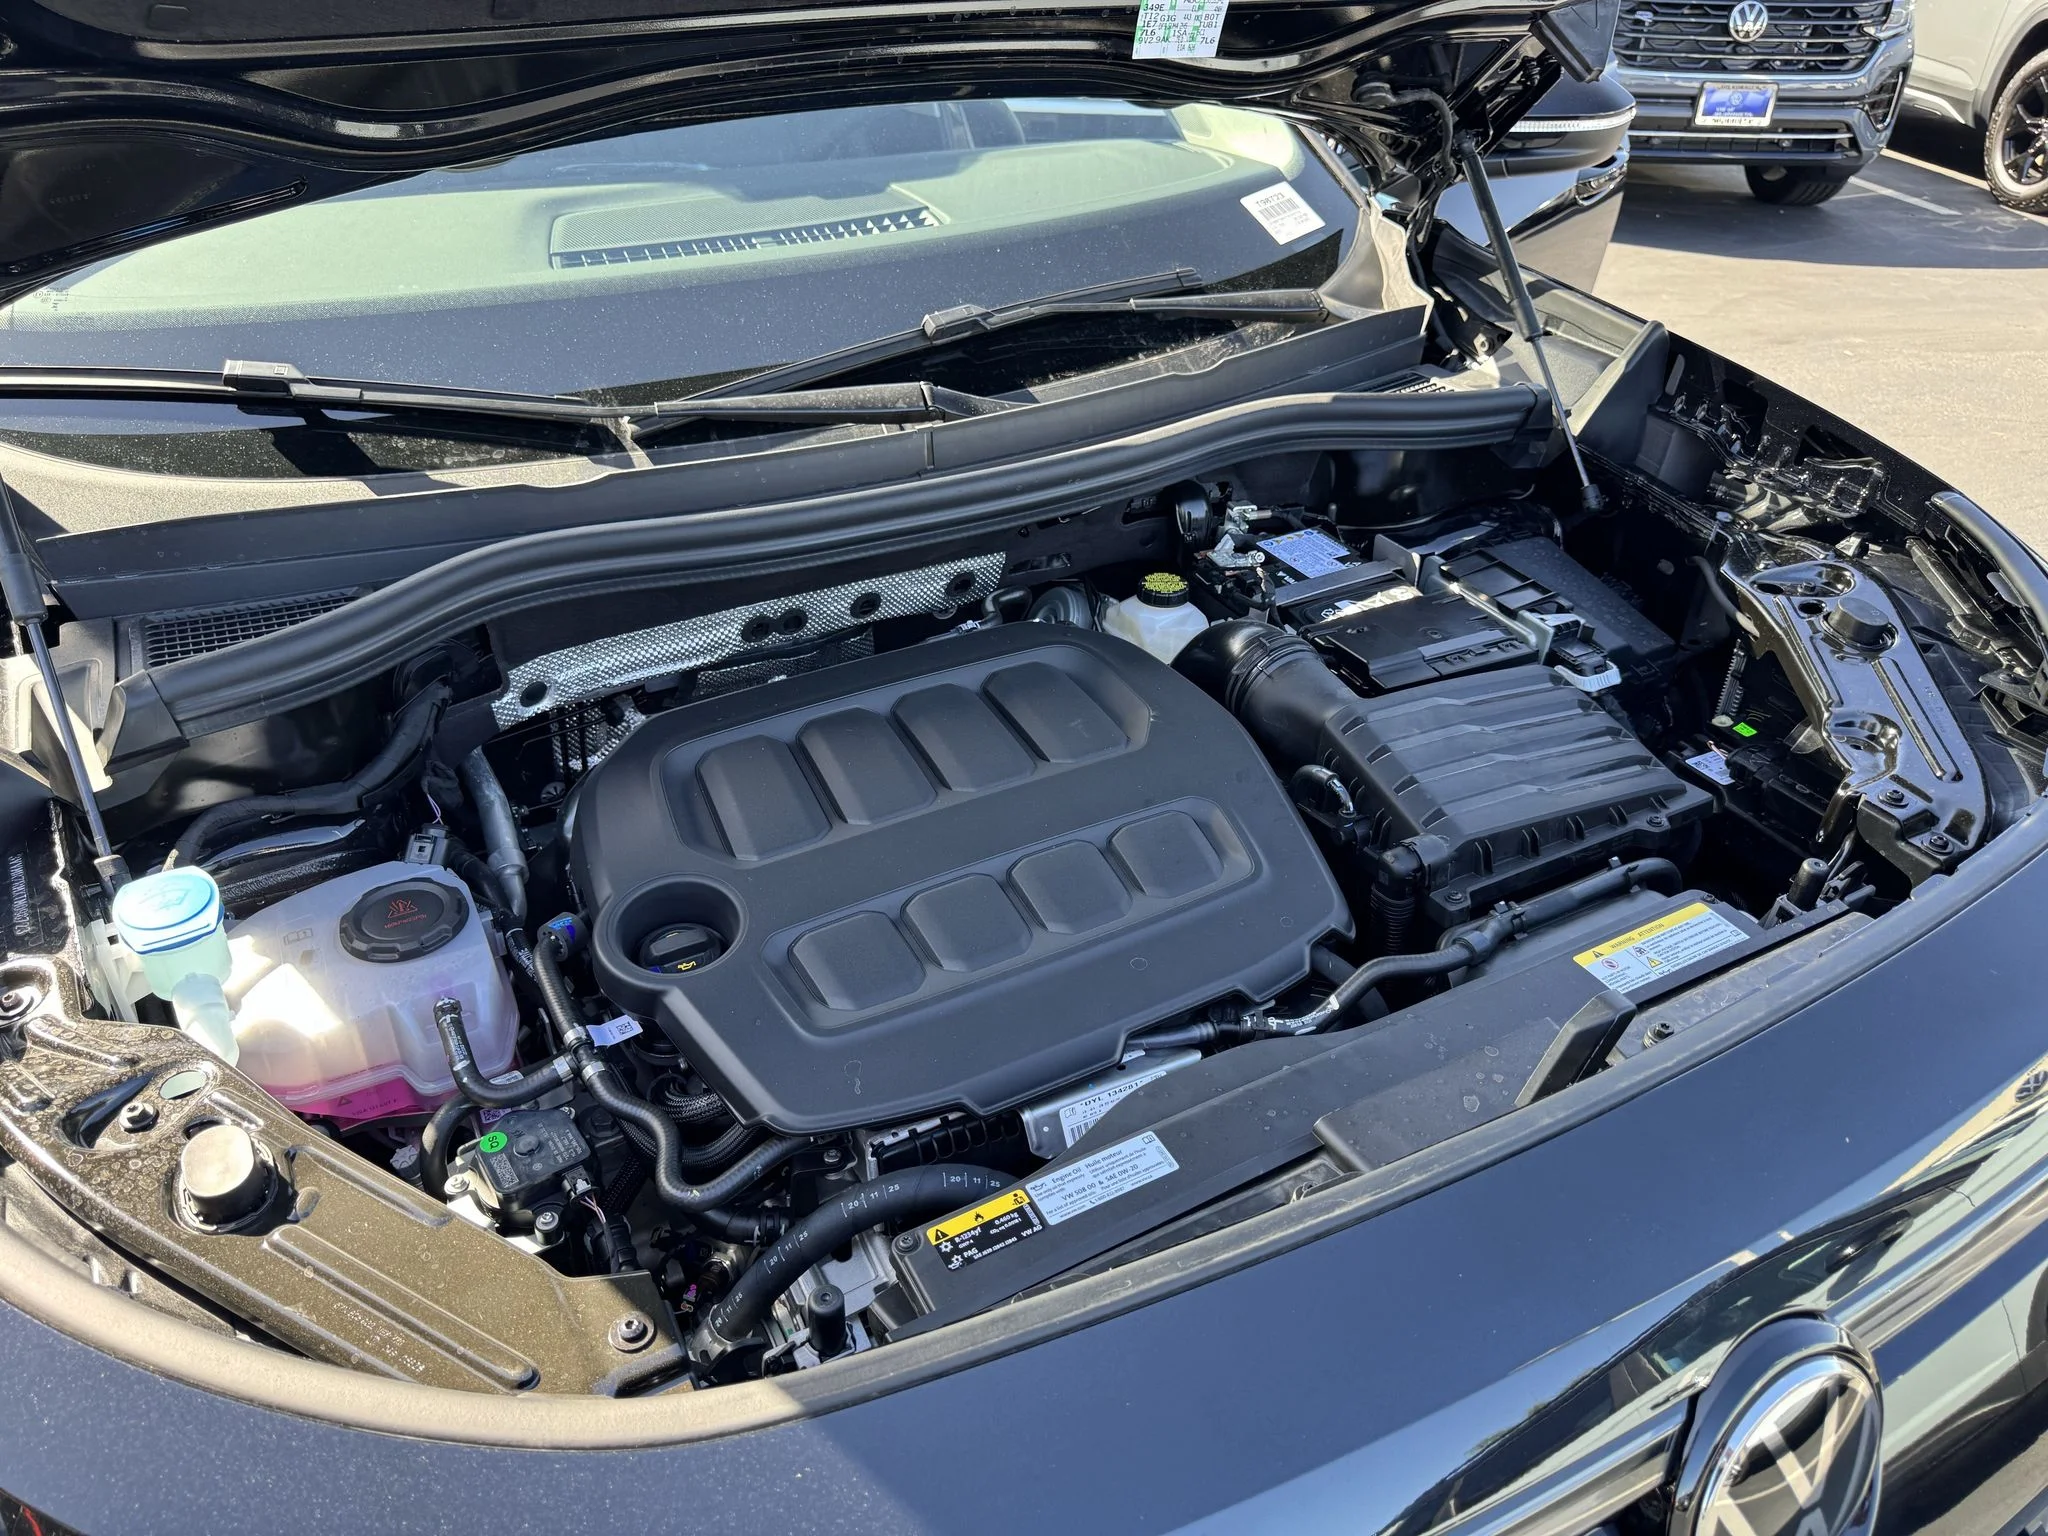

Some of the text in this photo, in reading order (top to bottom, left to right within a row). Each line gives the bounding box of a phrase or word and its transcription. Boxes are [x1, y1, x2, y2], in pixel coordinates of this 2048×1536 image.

[487, 1135, 499, 1148] SQ
[1085, 1149, 1122, 1168] Huile moteur
[1051, 1171, 1072, 1184] Engine
[1062, 1192, 1075, 1201] VW
[1074, 1186, 1087, 1195] 508
[1104, 1173, 1117, 1182] SAE
[1117, 1164, 1138, 1176] 0W-20
[1021, 1224, 1042, 1237] VW AG
[963, 1247, 978, 1257] PAG
